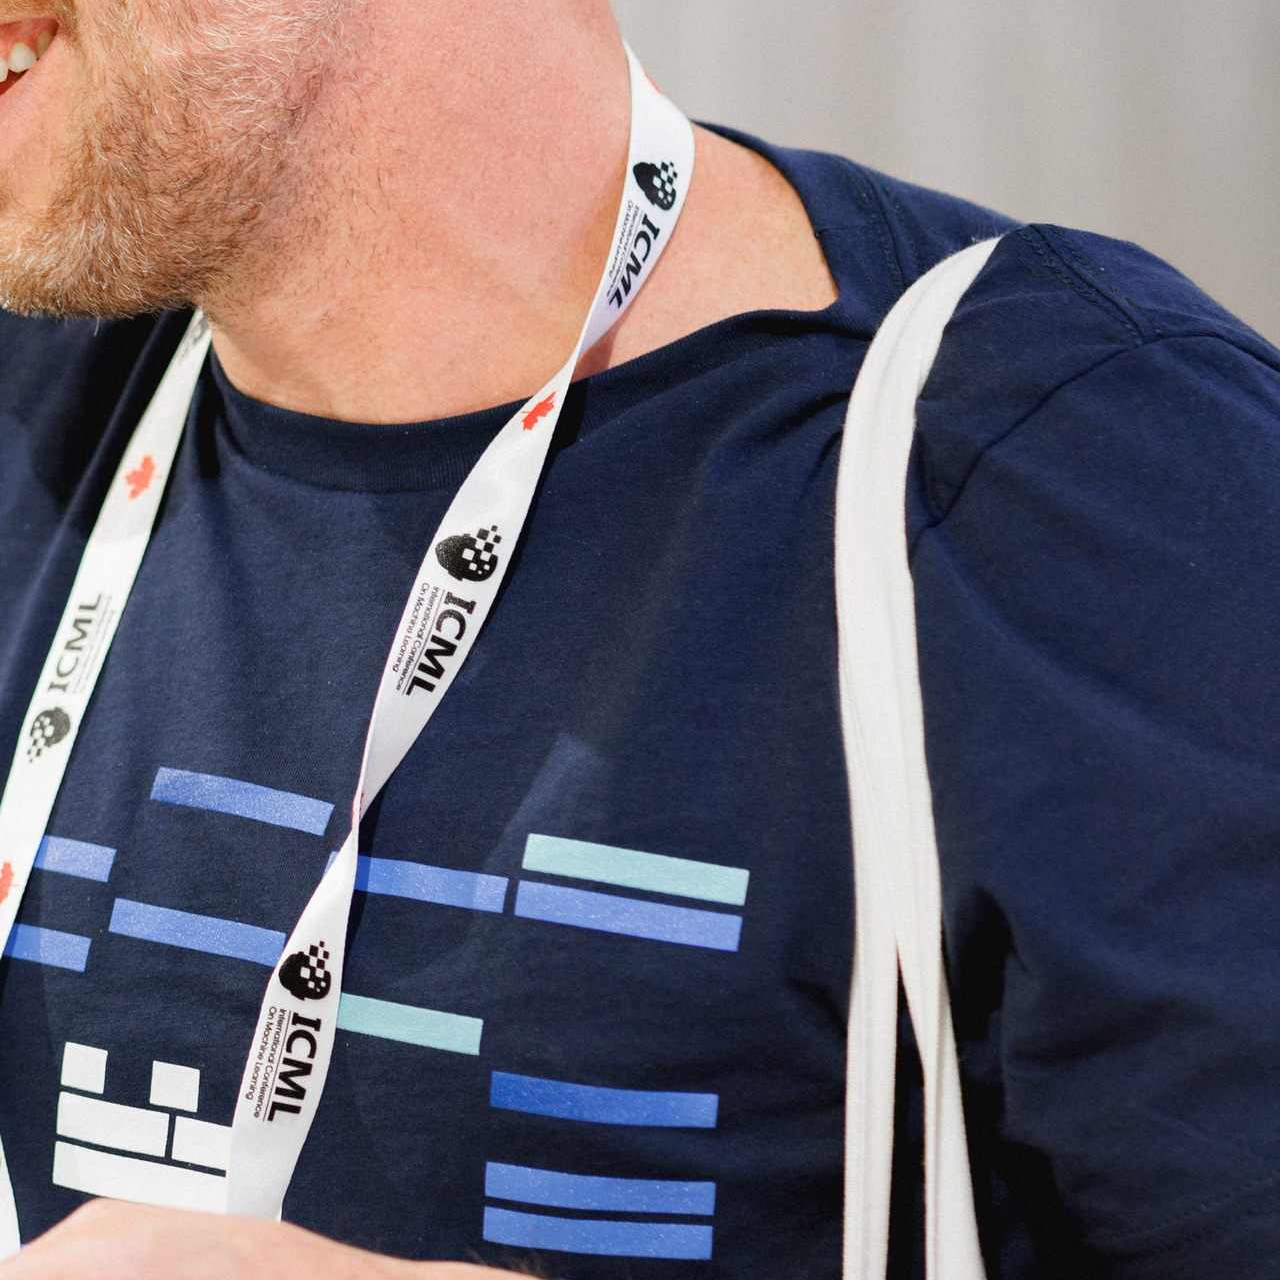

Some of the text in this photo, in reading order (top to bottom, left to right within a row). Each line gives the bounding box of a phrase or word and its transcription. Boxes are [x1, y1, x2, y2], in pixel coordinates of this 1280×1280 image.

[609, 213, 660, 308] ICML
[48, 593, 102, 693] ICML
[392, 582, 430, 673] On Machine Learning
[396, 586, 440, 691] International Conference
[406, 591, 476, 696] ICML
[245, 1006, 277, 1100] On Machine Learning
[253, 1008, 287, 1118] International Conference
[267, 1011, 321, 1122] ICML
